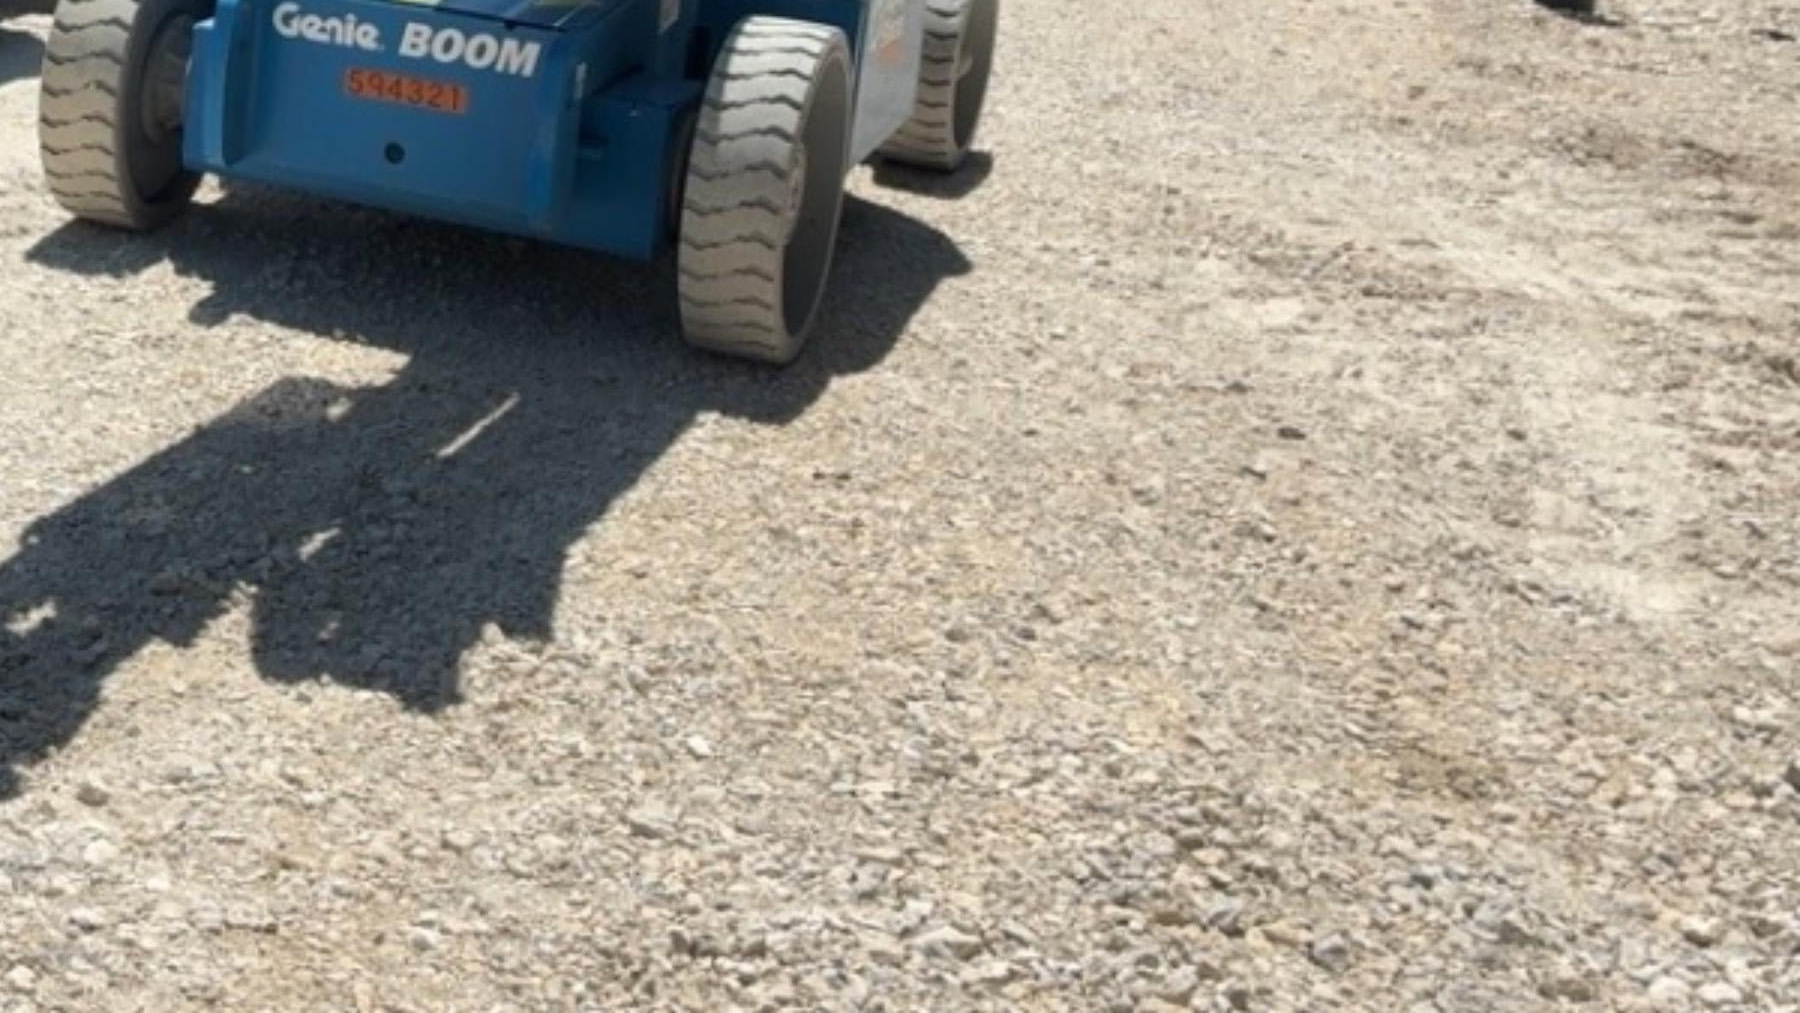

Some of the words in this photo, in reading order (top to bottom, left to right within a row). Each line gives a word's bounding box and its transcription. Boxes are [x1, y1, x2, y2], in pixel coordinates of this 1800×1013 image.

[272, 1, 382, 51] Genie
[400, 21, 541, 78] BOOM
[348, 69, 460, 111] 594321
